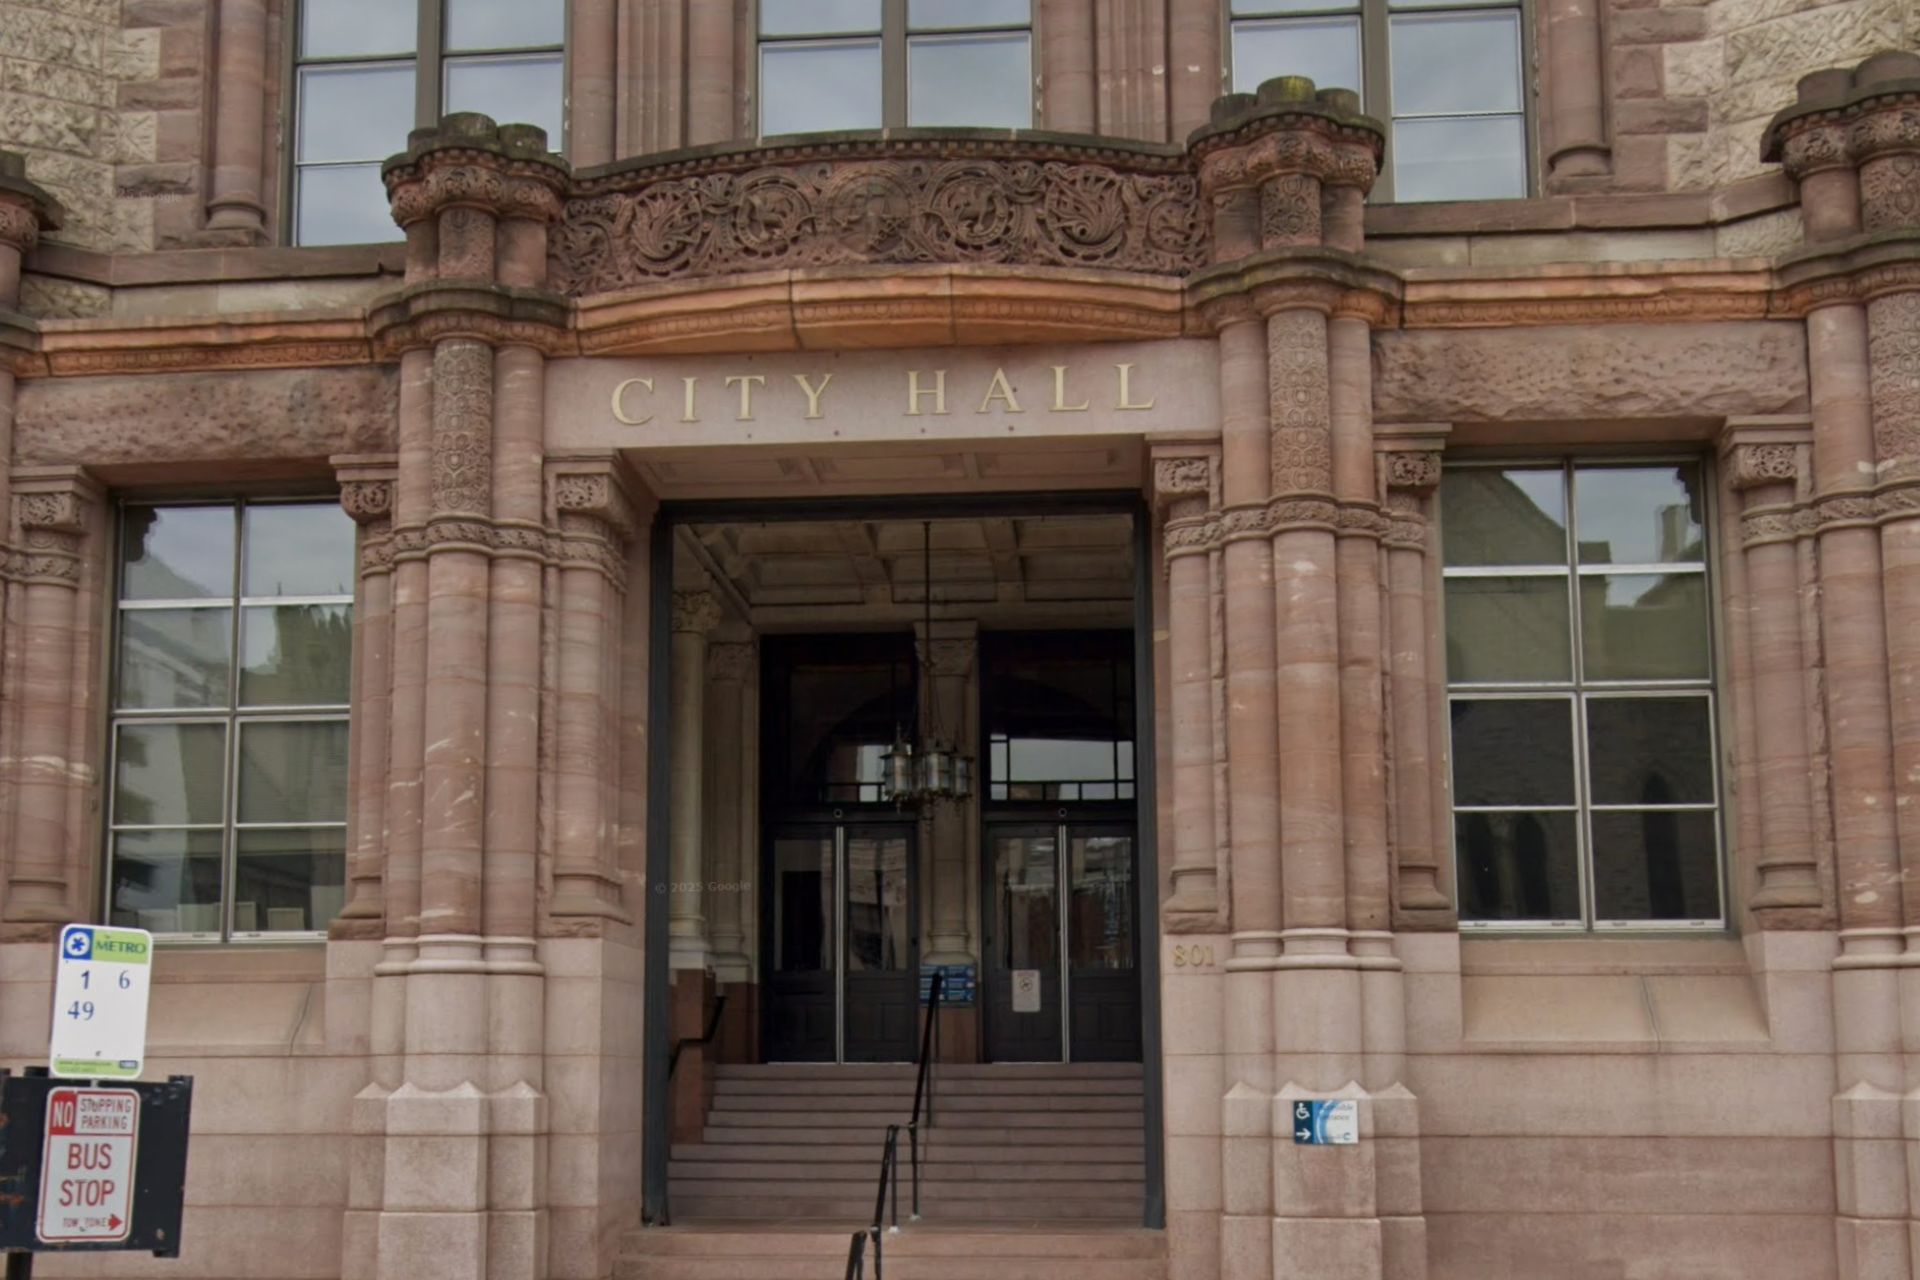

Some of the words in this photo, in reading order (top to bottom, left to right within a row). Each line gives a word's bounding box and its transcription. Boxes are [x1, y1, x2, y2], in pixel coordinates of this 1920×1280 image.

[610, 373, 834, 426] CITY
[903, 362, 1156, 416] HALL
[95, 939, 147, 955] METRO
[1173, 944, 1216, 967] 801
[81, 970, 91, 990] 1
[118, 969, 131, 990] 6
[67, 1001, 95, 1021] 49
[52, 1099, 73, 1129] NO
[80, 1098, 132, 1114] STOPPING
[81, 1115, 128, 1131] PARKING
[67, 1143, 112, 1171] BUS
[59, 1180, 115, 1208] STOP
